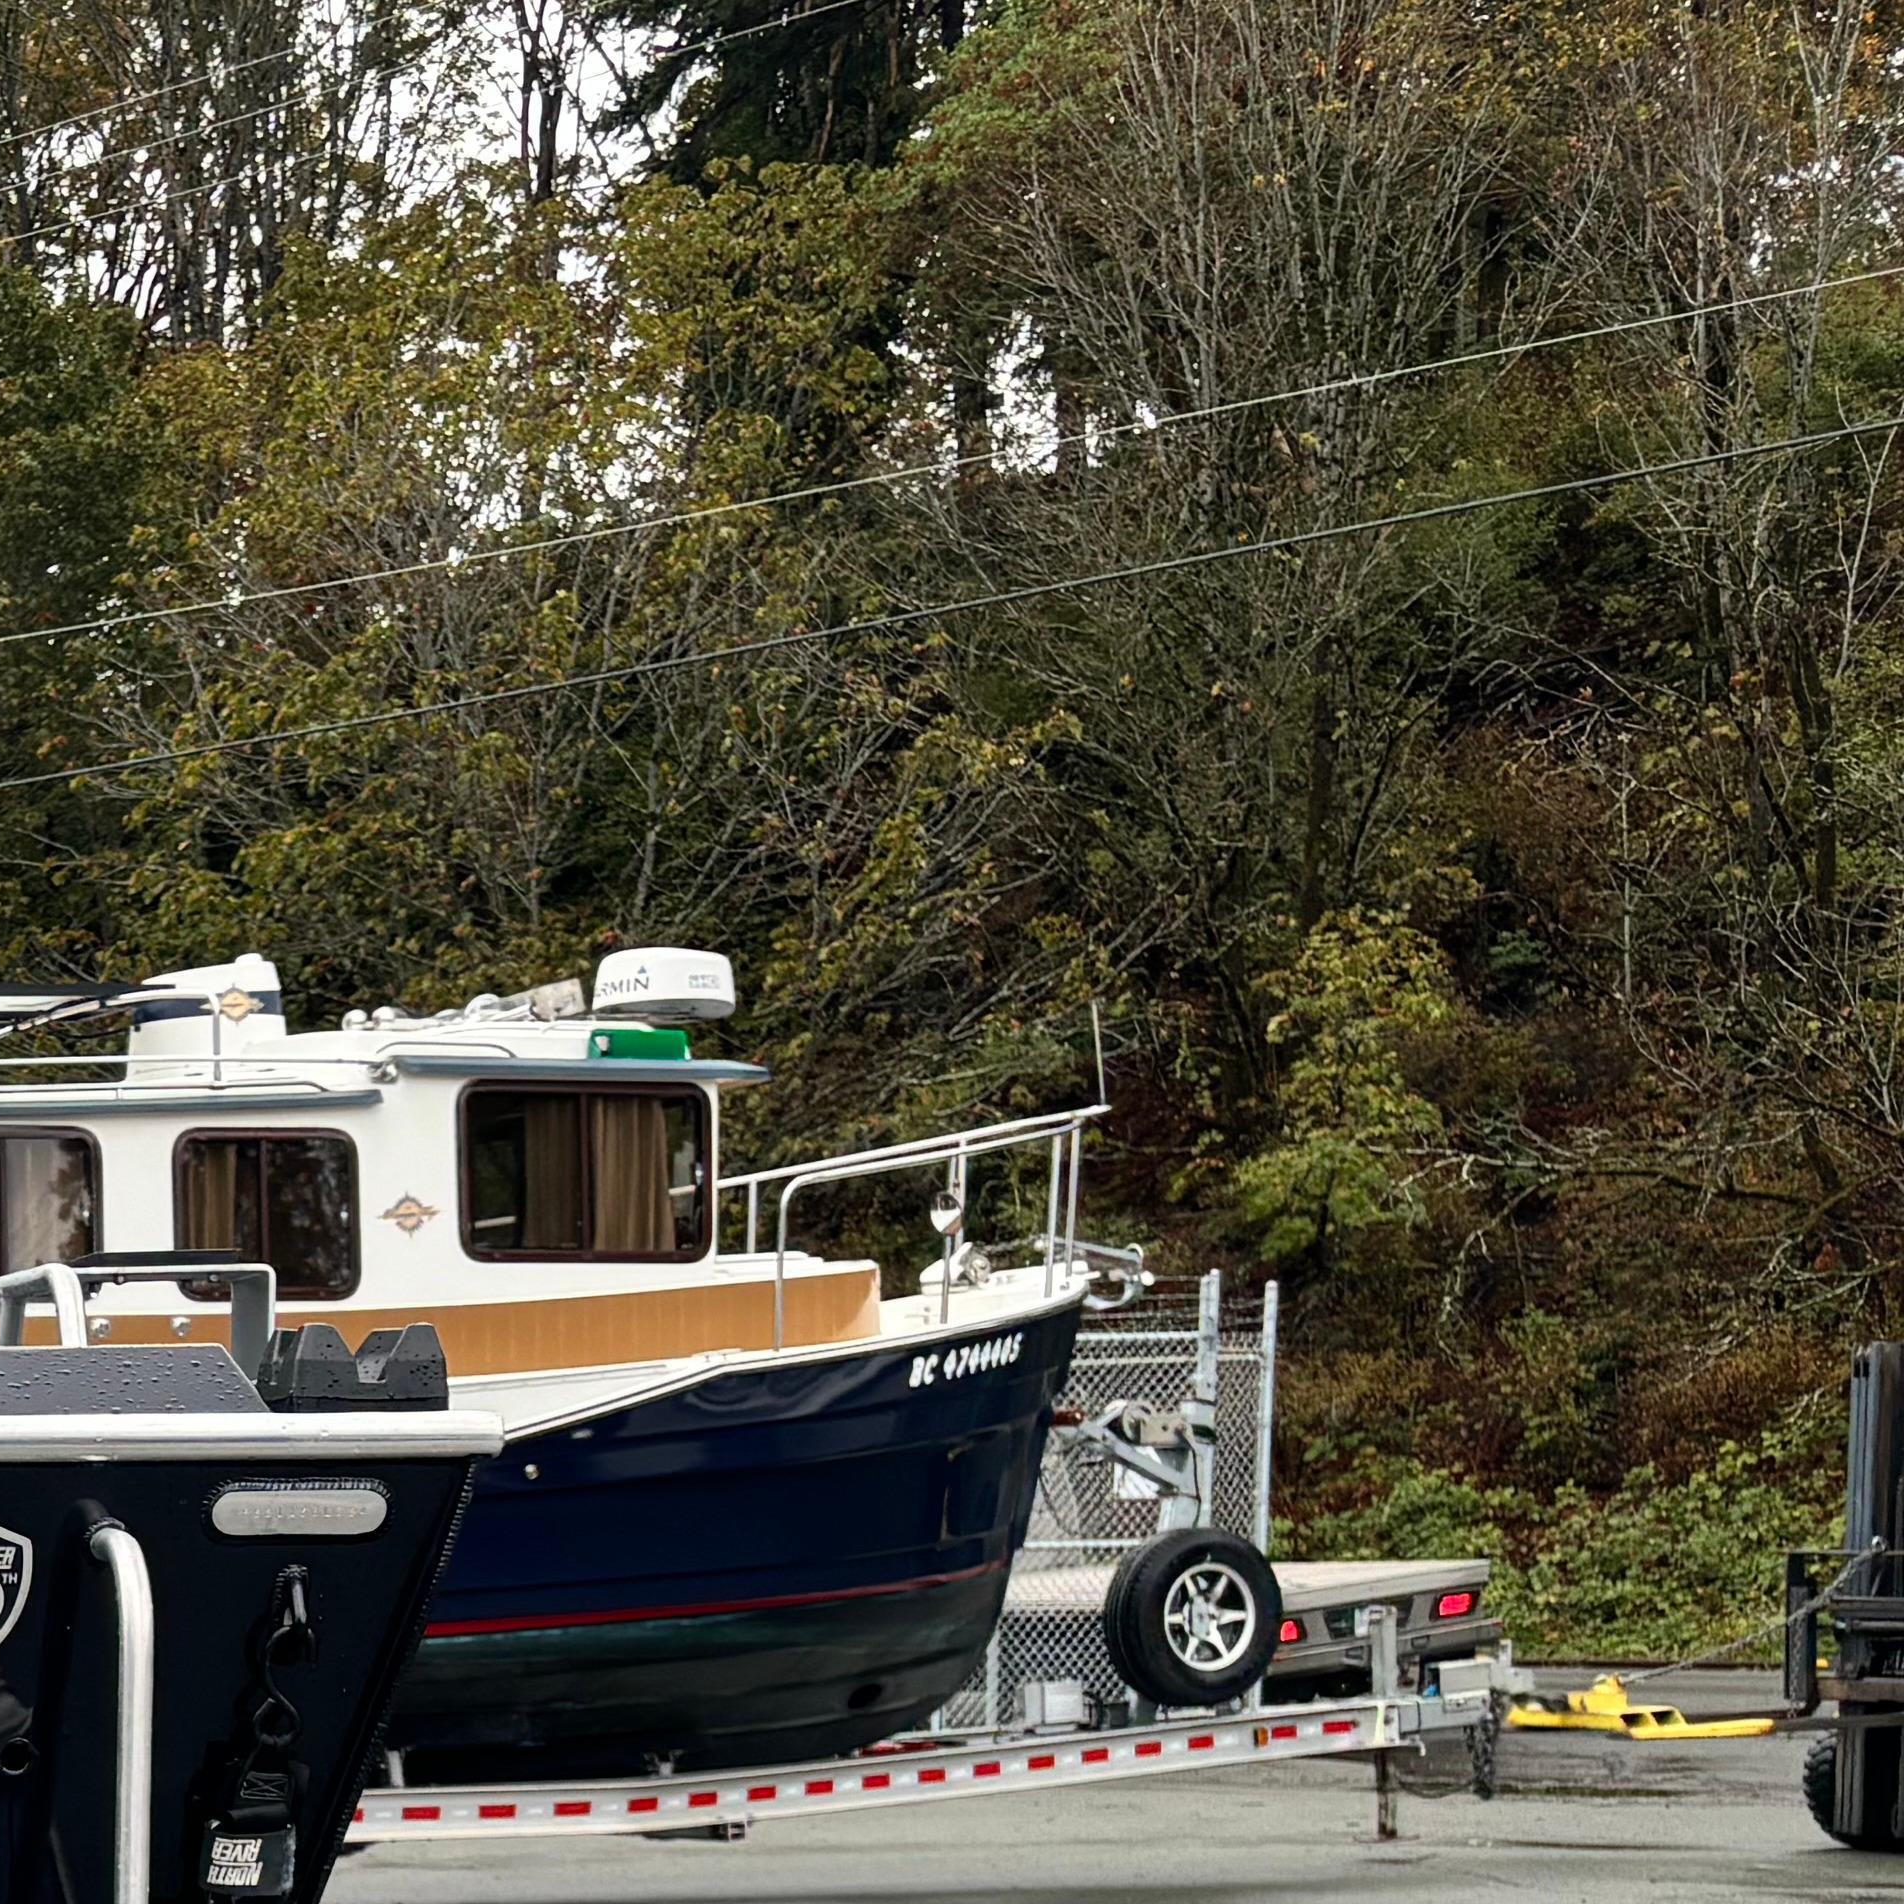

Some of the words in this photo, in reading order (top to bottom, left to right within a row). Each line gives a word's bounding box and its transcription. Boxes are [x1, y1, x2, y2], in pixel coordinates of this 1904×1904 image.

[909, 1354, 939, 1388] BC
[2, 1572, 18, 1584] TH
[211, 1837, 263, 1862] RIVER
[206, 1860, 264, 1886] NORTH
